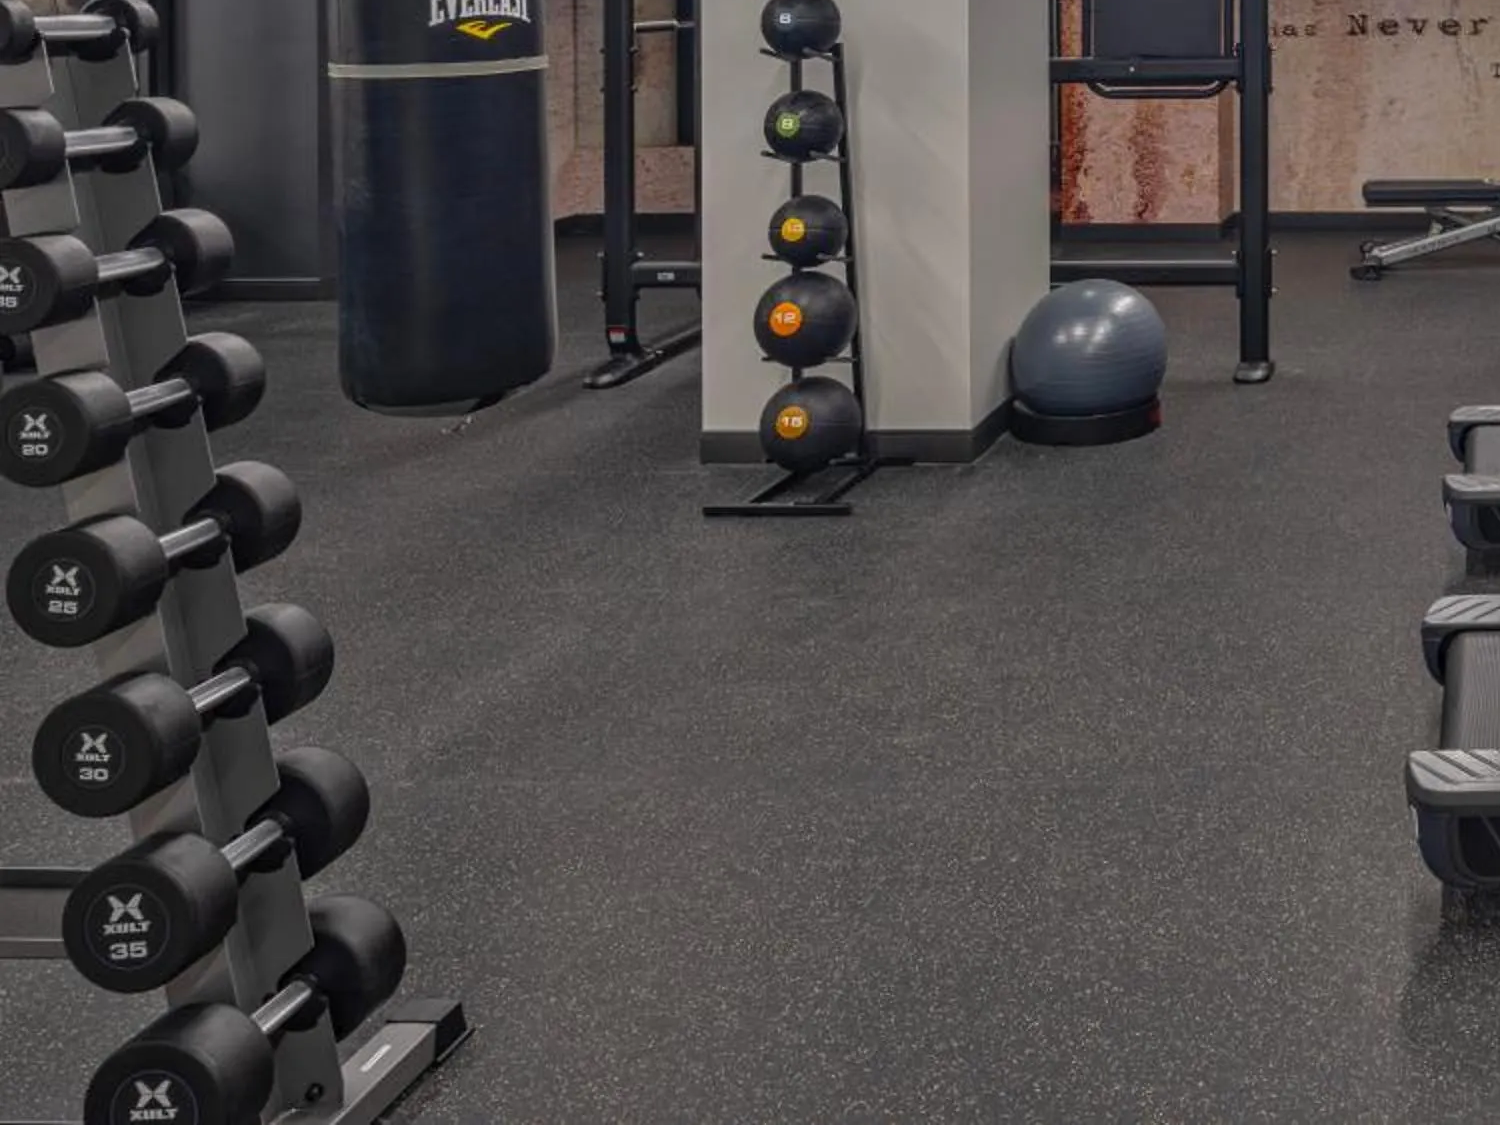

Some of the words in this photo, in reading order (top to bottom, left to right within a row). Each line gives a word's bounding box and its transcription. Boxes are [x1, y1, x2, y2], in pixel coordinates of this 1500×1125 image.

[1347, 13, 1491, 37] Never
[21, 444, 49, 456] 20
[47, 600, 78, 615] 25
[79, 767, 109, 783] 30
[108, 940, 148, 960] 35
